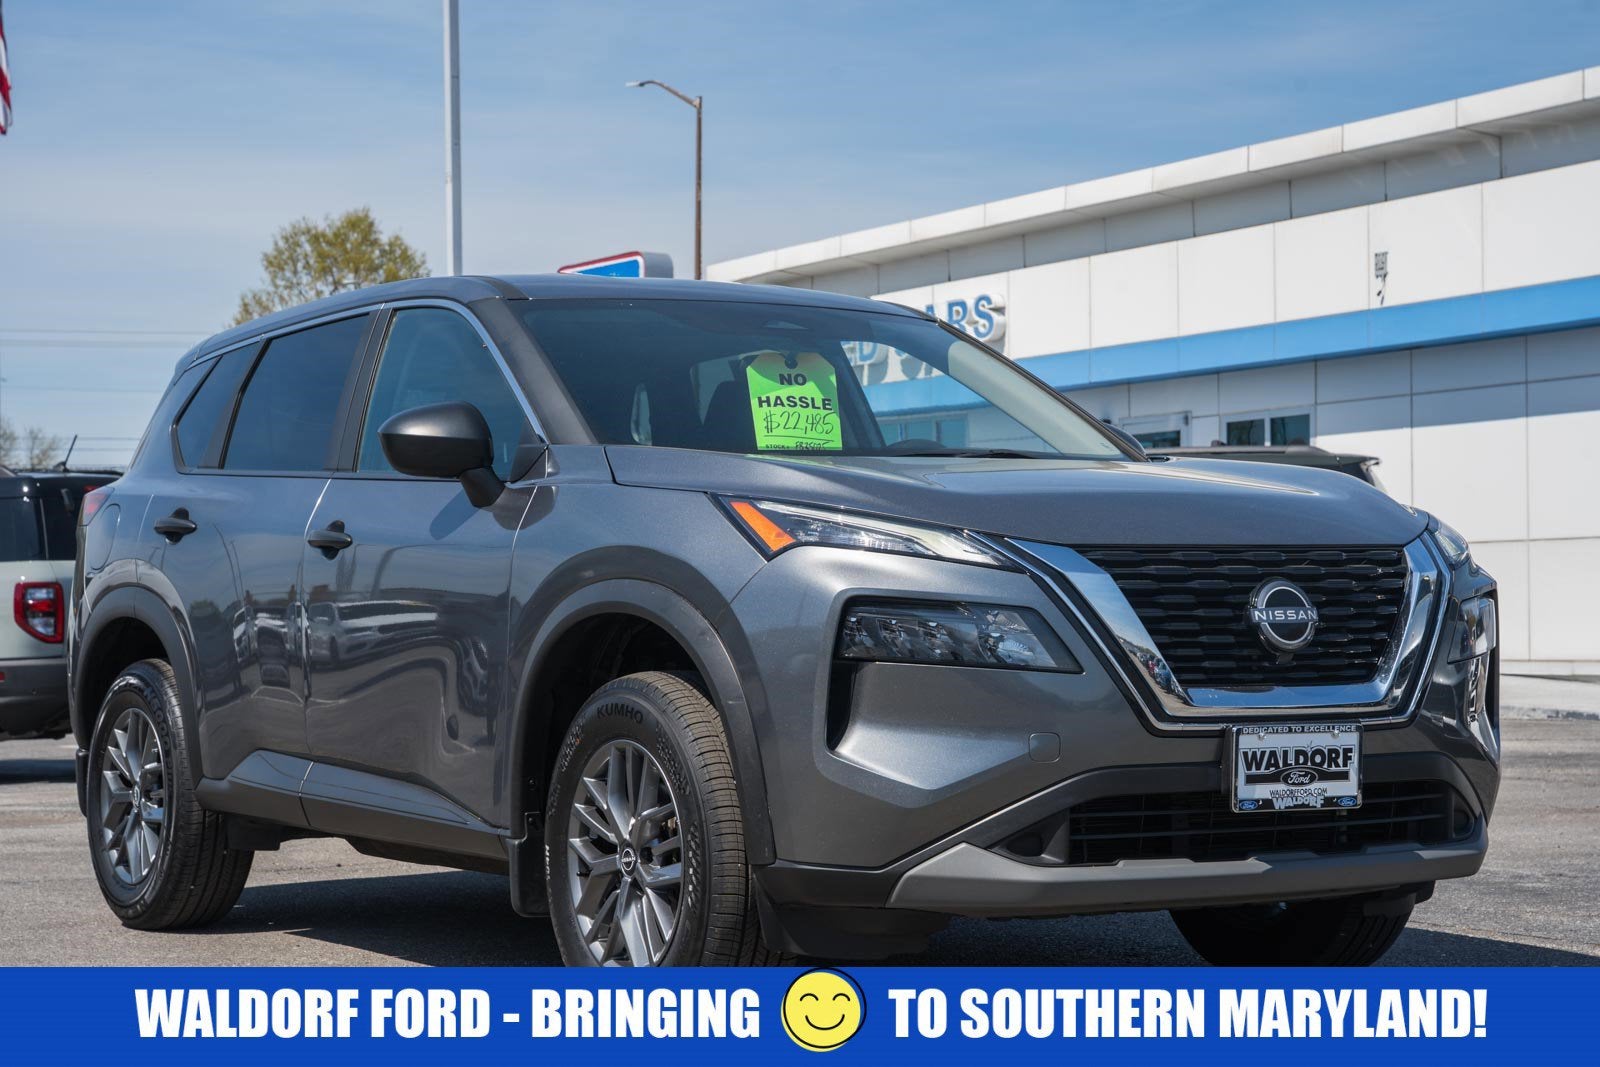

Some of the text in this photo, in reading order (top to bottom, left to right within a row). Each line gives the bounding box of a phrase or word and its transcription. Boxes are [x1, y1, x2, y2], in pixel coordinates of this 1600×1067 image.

[778, 373, 807, 386] NO
[757, 395, 833, 411] HASSLE
[763, 410, 836, 435] $22,485
[1254, 610, 1317, 621] NISSAN
[597, 702, 644, 725] KUMHO
[1304, 725, 1357, 733] EXCELLENCE
[1241, 747, 1355, 772] WALDORF
[1287, 771, 1311, 784] Ford
[1269, 788, 1328, 797] WALDORFFORD.COM
[1271, 795, 1325, 810] WALDORF
[1341, 798, 1355, 806] Ford
